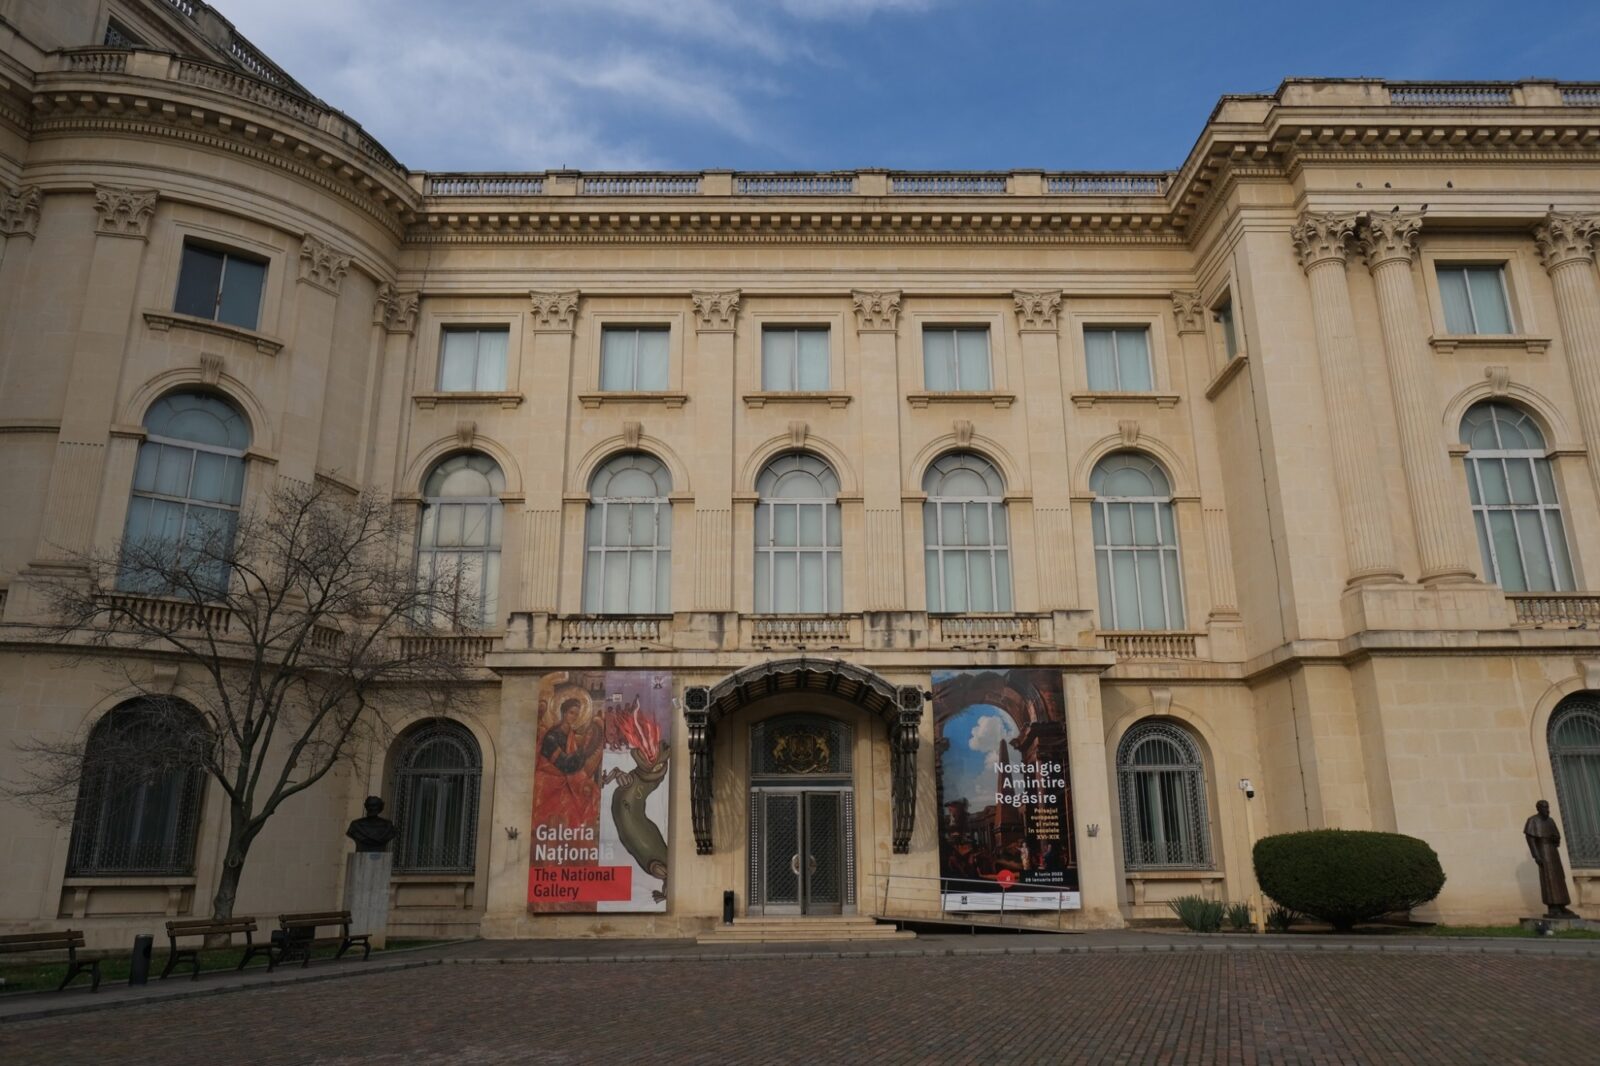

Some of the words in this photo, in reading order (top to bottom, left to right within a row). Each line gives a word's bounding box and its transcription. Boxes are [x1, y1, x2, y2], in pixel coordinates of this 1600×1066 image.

[994, 761, 1061, 776] Nostalgie
[1003, 777, 1065, 788] Amintire
[995, 792, 1057, 808] Regăsire
[536, 824, 594, 840] Galeria
[534, 868, 557, 881] The
[561, 868, 615, 881] National
[534, 884, 579, 900] Gallery
